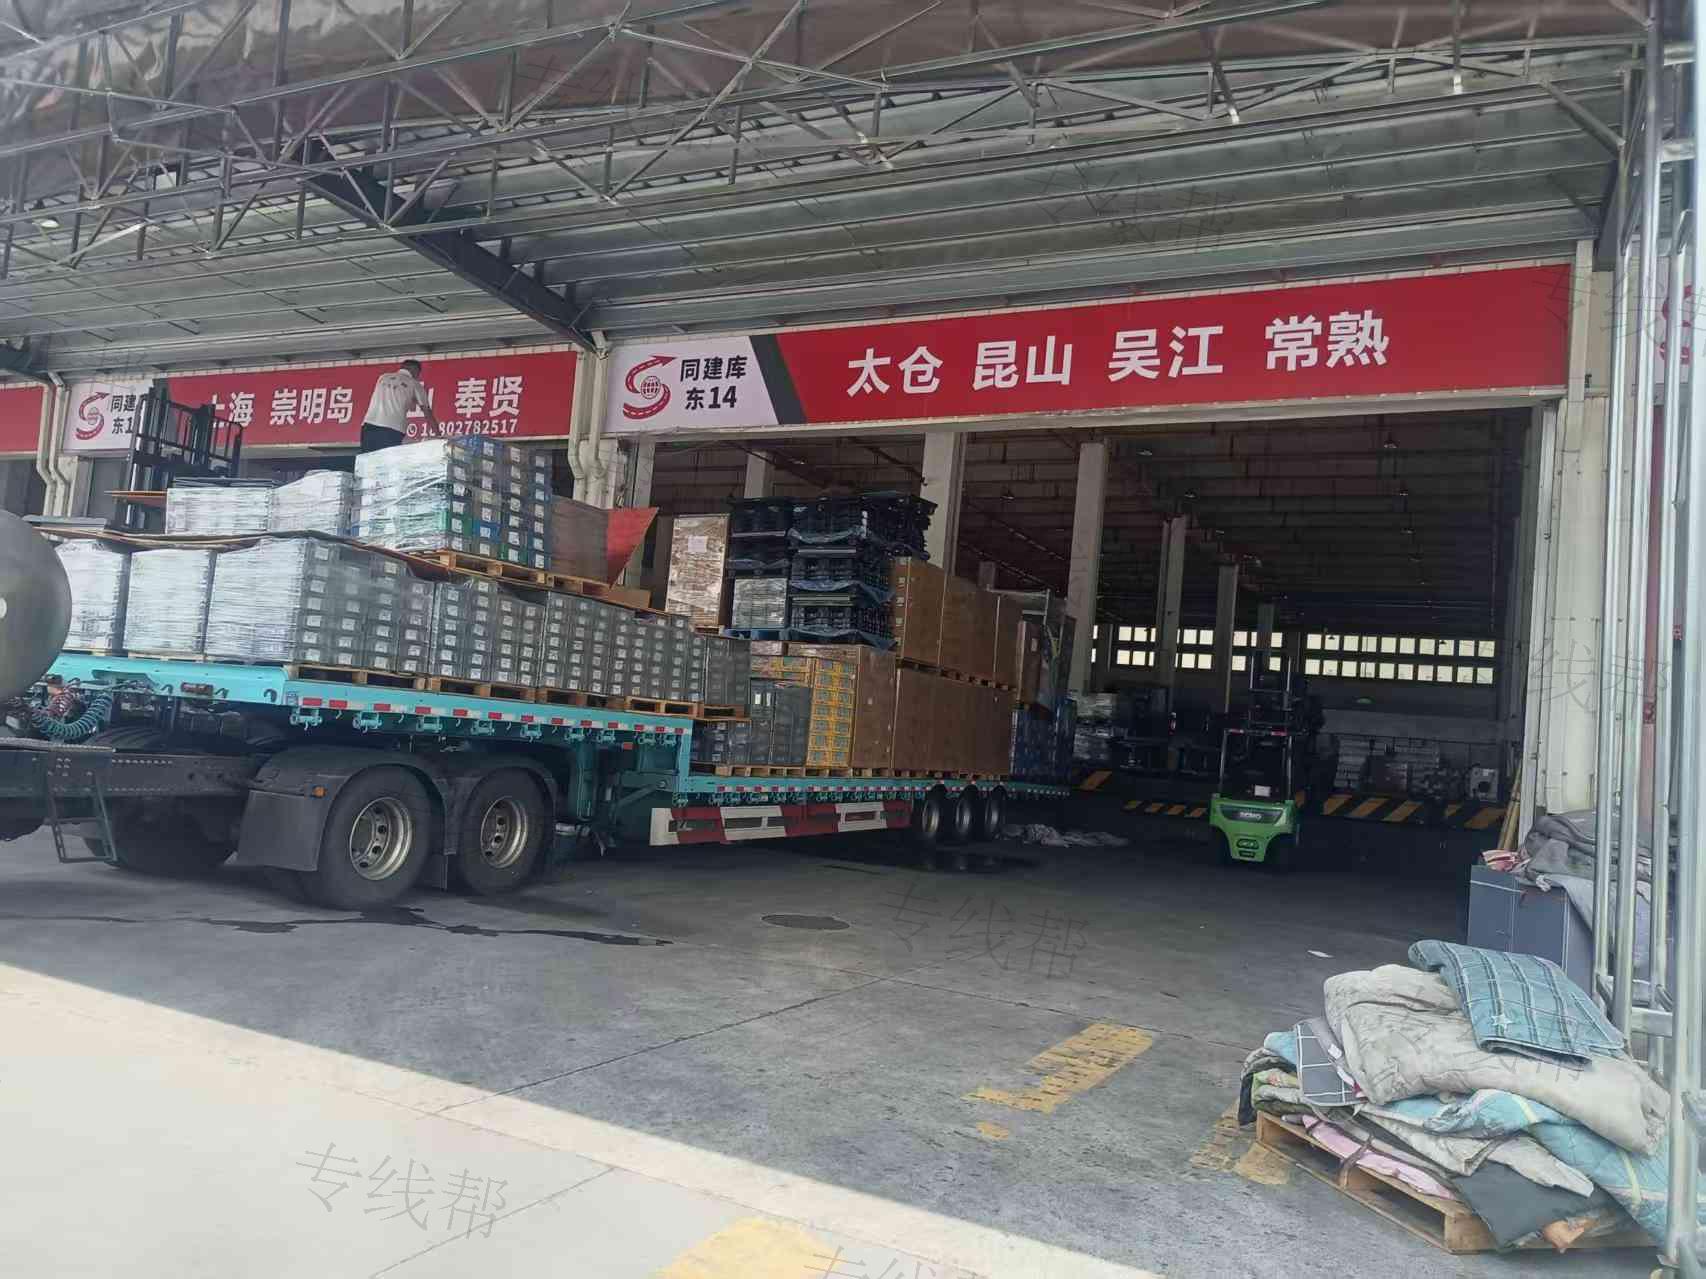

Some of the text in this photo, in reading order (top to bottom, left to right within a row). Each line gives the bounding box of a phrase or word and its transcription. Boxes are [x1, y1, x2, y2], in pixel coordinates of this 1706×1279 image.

[846, 309, 1390, 398] 太仓 昆山 吴江 常熟
[680, 354, 748, 384] 同建库
[110, 393, 146, 413] 同建
[269, 387, 354, 425] 崇明岛
[454, 376, 523, 418] 奉贤
[684, 385, 738, 411] 东14
